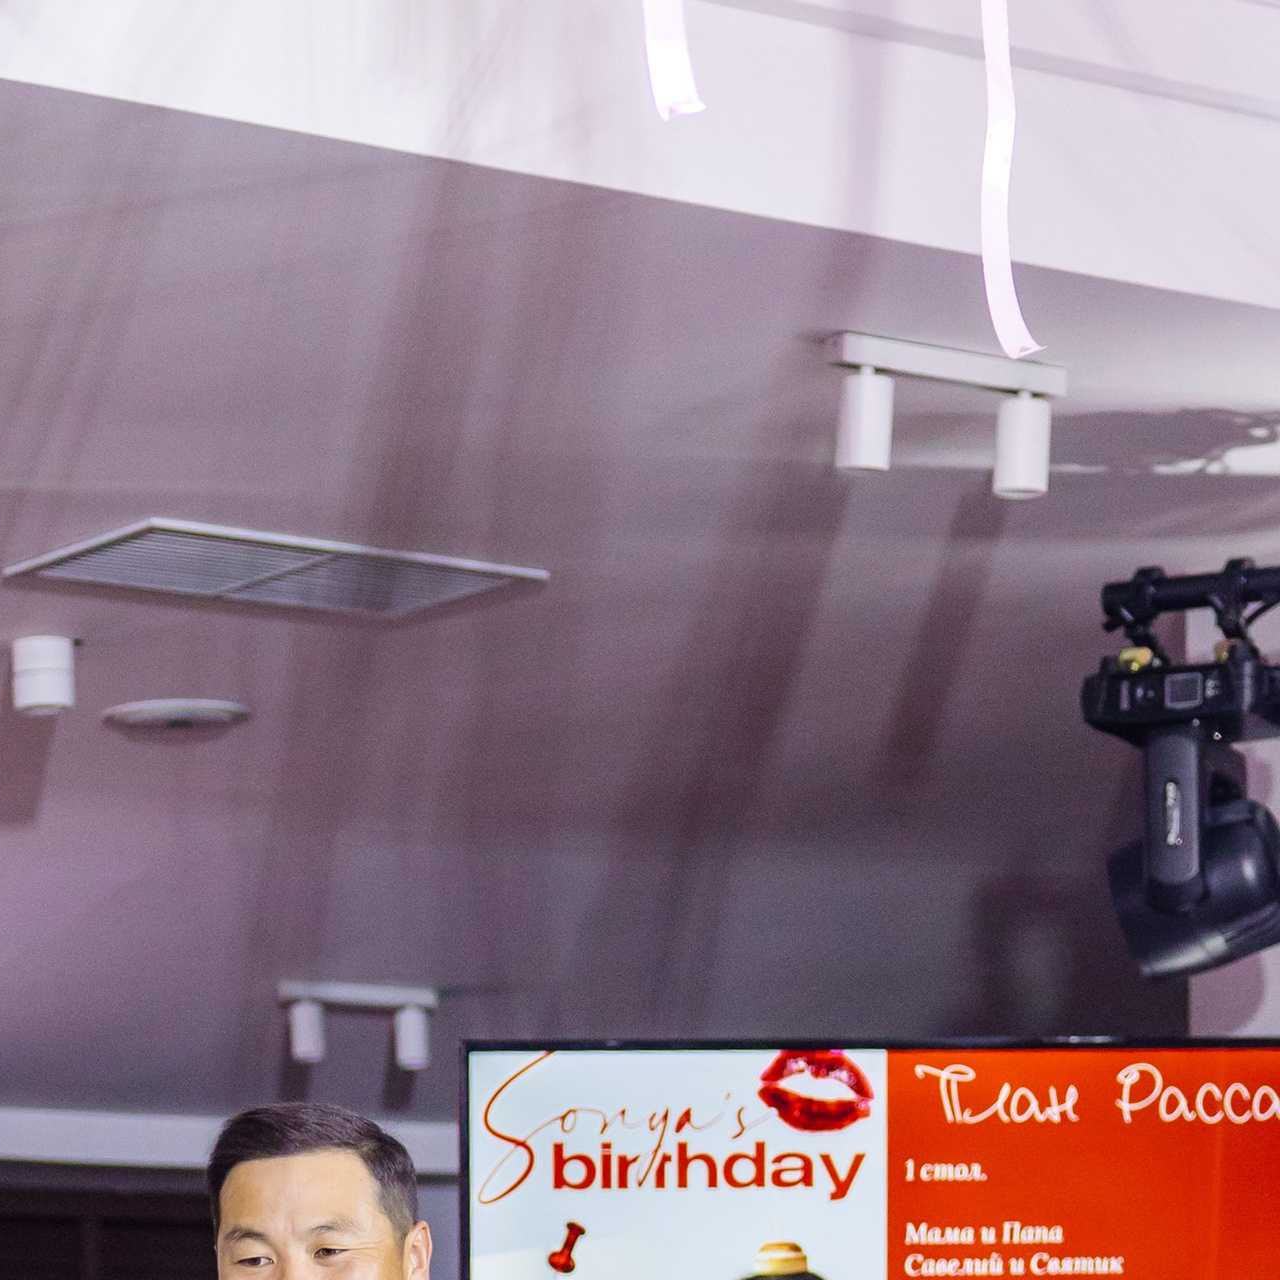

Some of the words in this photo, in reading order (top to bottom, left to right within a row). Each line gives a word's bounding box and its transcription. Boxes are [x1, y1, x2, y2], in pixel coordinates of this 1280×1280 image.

[915, 1064, 1080, 1124] План
[552, 1140, 867, 1200] birthday
[905, 1158, 915, 1182] 1
[920, 1162, 988, 1181] стол.
[904, 1222, 975, 1245] Мама
[980, 1226, 997, 1245] и
[1002, 1220, 1063, 1245] Папа
[904, 1251, 1004, 1277] Савелий
[1009, 1257, 1026, 1275] и
[1029, 1252, 1125, 1275] Святик
